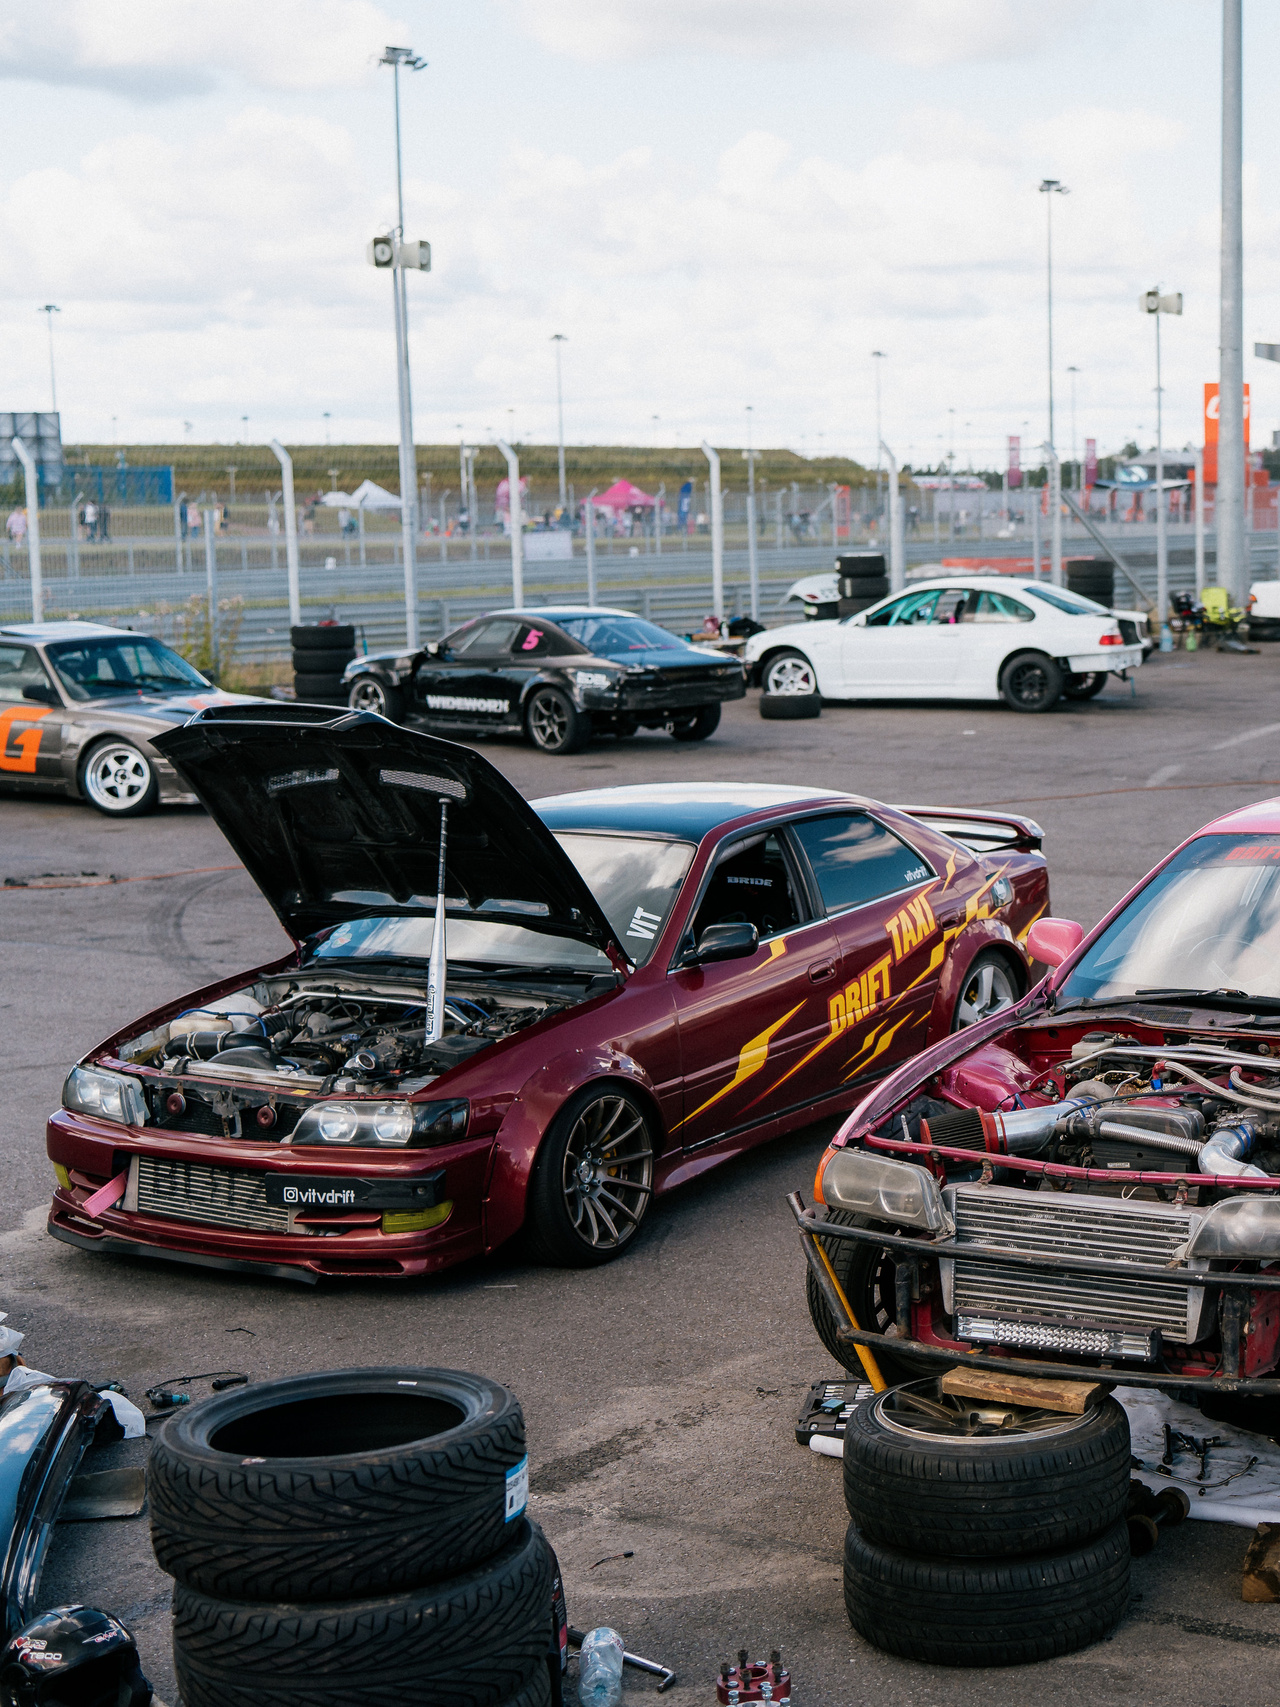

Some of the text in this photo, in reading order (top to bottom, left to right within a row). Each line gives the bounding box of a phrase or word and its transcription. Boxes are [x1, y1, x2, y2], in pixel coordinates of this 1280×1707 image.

[522, 629, 544, 650] 5
[727, 876, 773, 887] BRIDE
[626, 906, 662, 940] VIT
[829, 892, 936, 1034] DRIFT TAXI
[299, 1189, 355, 1203] vitvdrift
